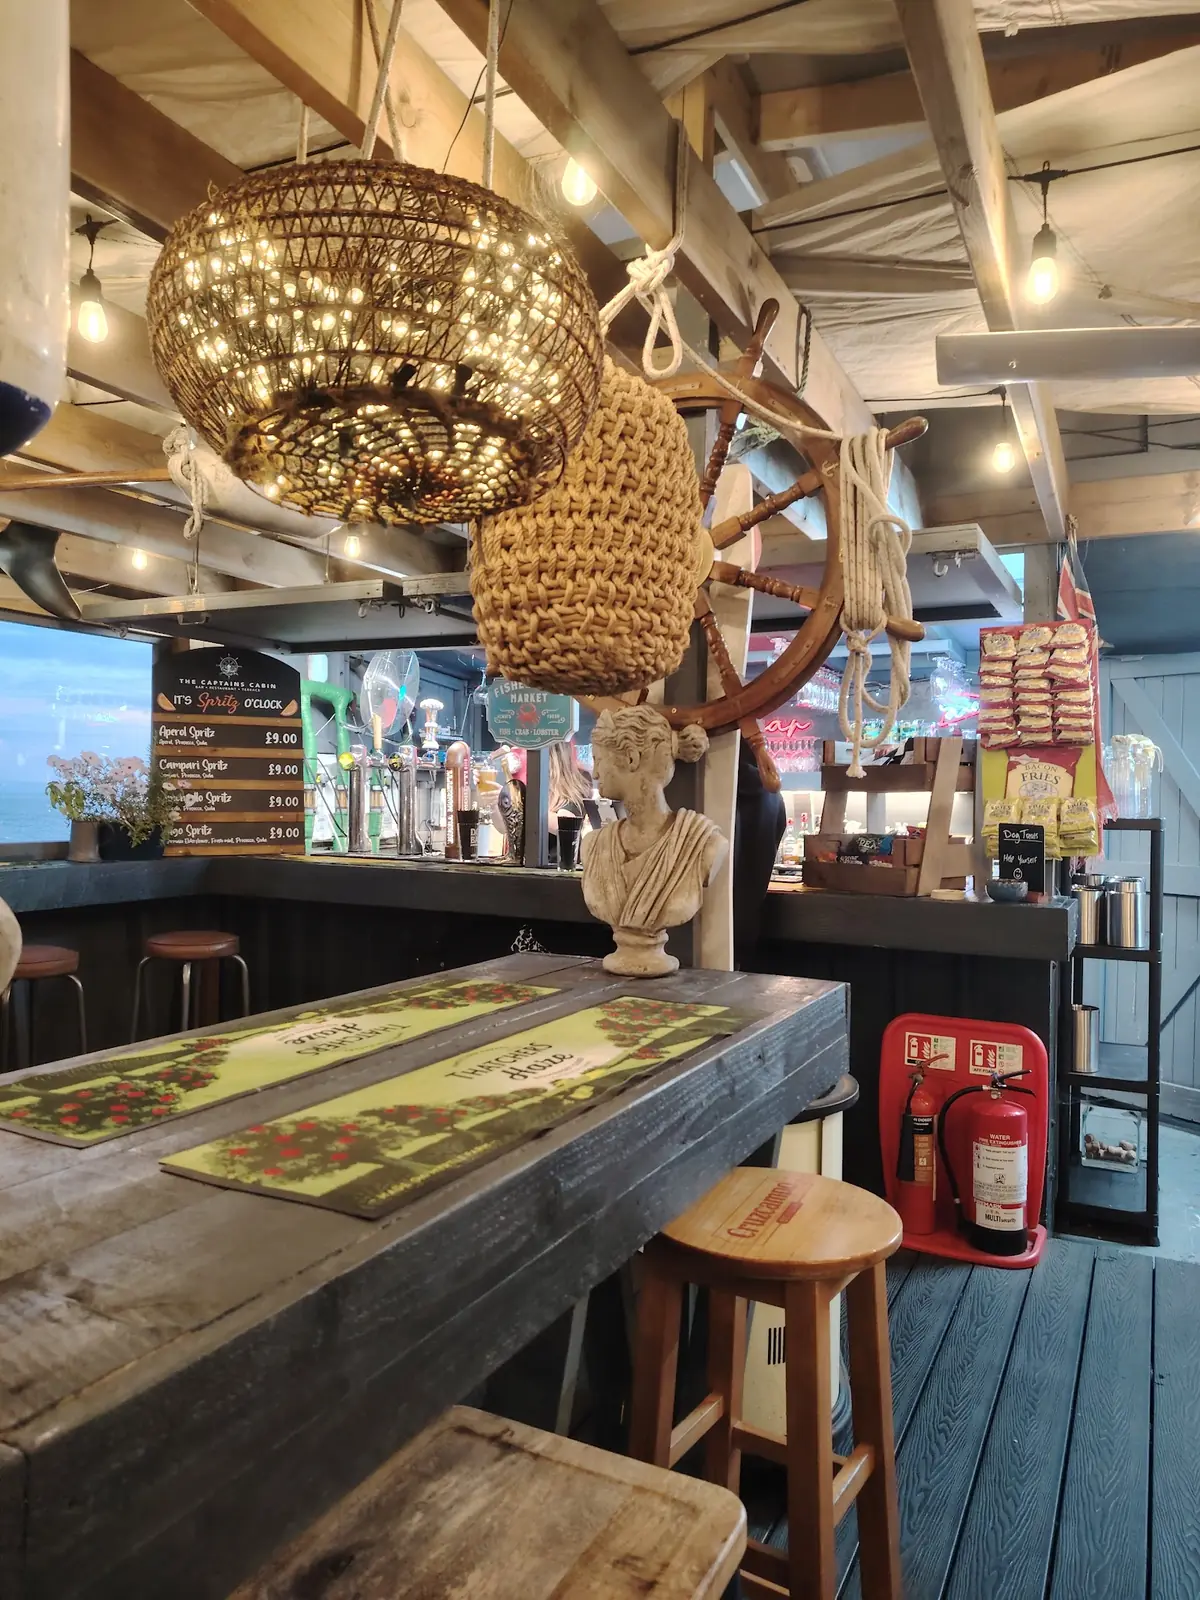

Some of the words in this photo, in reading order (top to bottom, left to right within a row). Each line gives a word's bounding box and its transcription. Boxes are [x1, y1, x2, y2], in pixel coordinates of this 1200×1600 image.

[201, 680, 245, 688] CAPTAINS
[174, 695, 192, 706] IT'S
[196, 691, 241, 714] Spritz
[244, 698, 283, 710] O'CLOCK
[510, 692, 548, 703] MARKET
[159, 725, 187, 739] Aperol
[188, 726, 216, 740] Spritz
[265, 732, 298, 745] £9.00
[515, 728, 530, 736] CRAB
[533, 728, 559, 736] LOBSTER
[159, 759, 200, 773] Campari
[201, 759, 229, 772] Spritz
[268, 763, 299, 776] £9.00
[1024, 763, 1058, 772] BACON
[1021, 772, 1061, 785] FRIES
[205, 791, 232, 806] Spritz
[268, 796, 299, 808] £9.00
[185, 823, 213, 838] Spritz
[269, 827, 300, 839] £9.00
[1003, 829, 1020, 844] Dog
[284, 1022, 363, 1045] Haze
[296, 1023, 411, 1056] THATCHERS
[445, 1042, 552, 1080] THATCHERS
[501, 1053, 574, 1081] Haze
